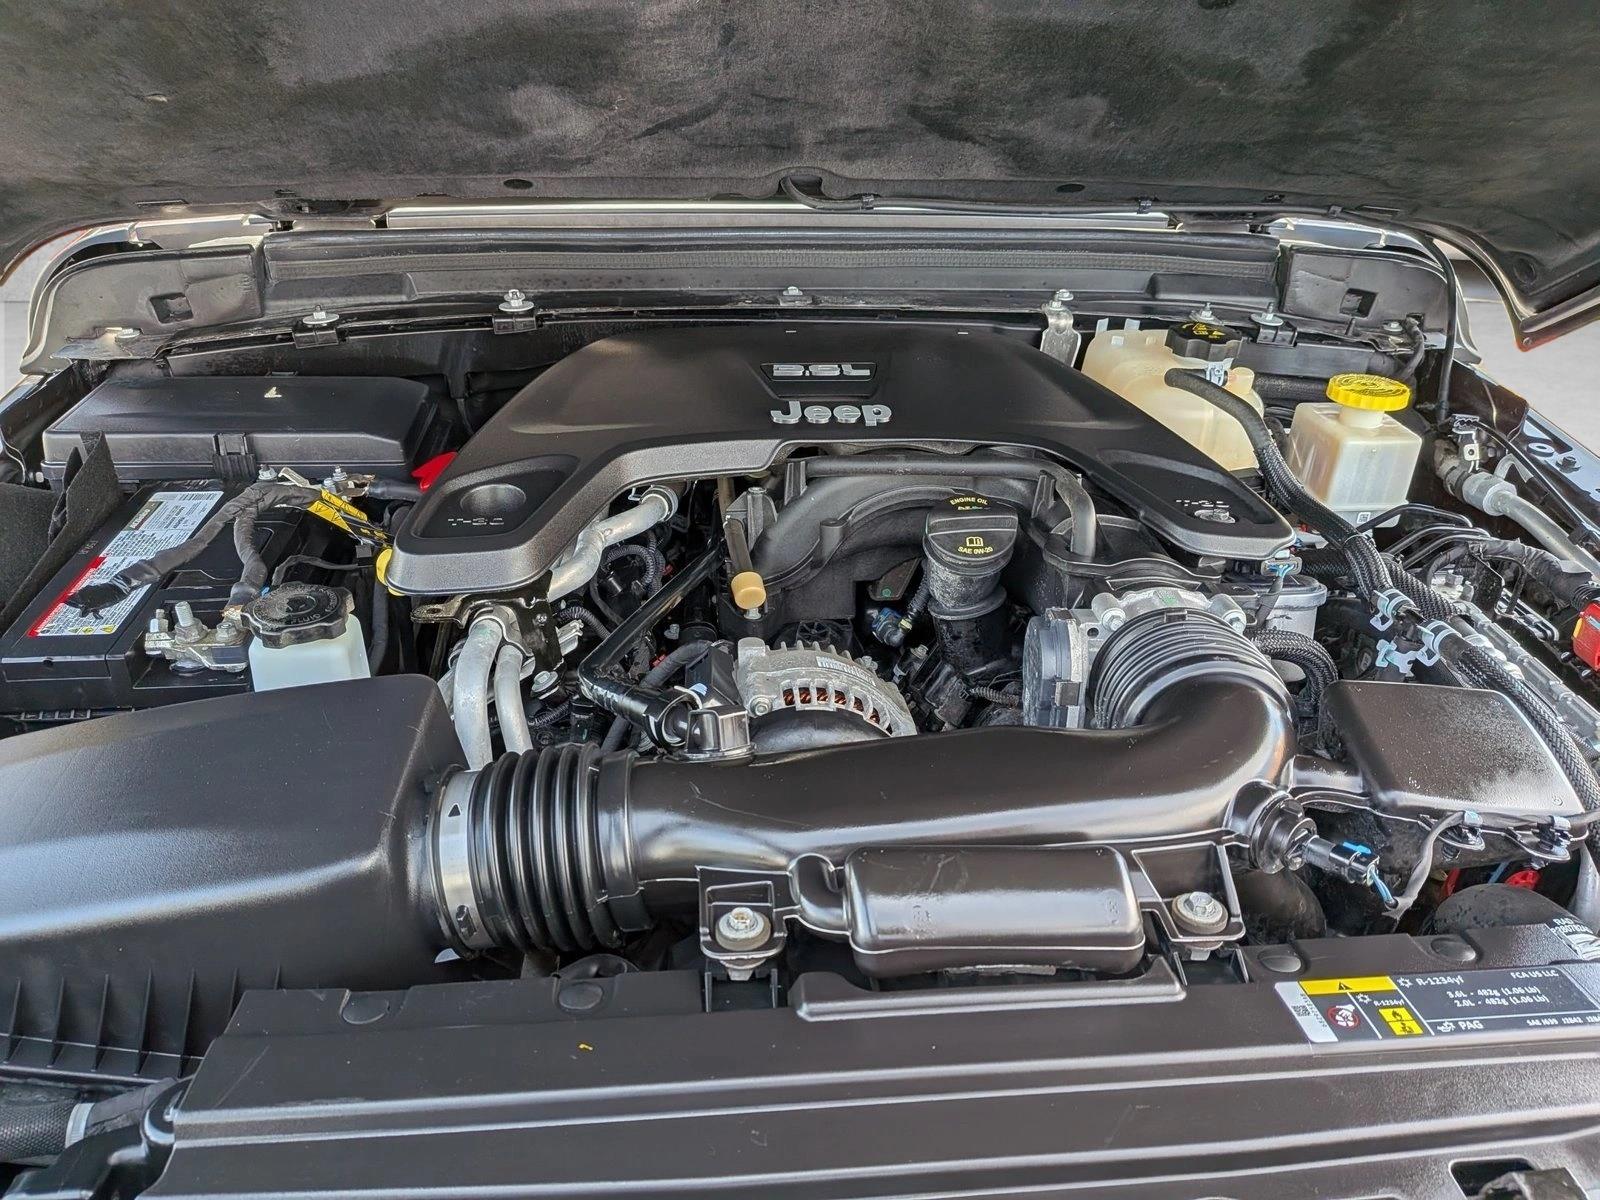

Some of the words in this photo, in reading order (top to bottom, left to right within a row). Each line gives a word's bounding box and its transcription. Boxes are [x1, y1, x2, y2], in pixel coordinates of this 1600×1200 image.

[770, 400, 892, 426] Jeep
[950, 497, 976, 505] ENGINE
[958, 546, 972, 554] SAE
[1528, 970, 1543, 978] US
[1542, 969, 1559, 977] LLC
[1415, 975, 1464, 985] R-1234yf
[1446, 990, 1467, 998] 3.6L
[1454, 999, 1475, 1007] 2.0L
[1458, 1020, 1484, 1030] PAG
